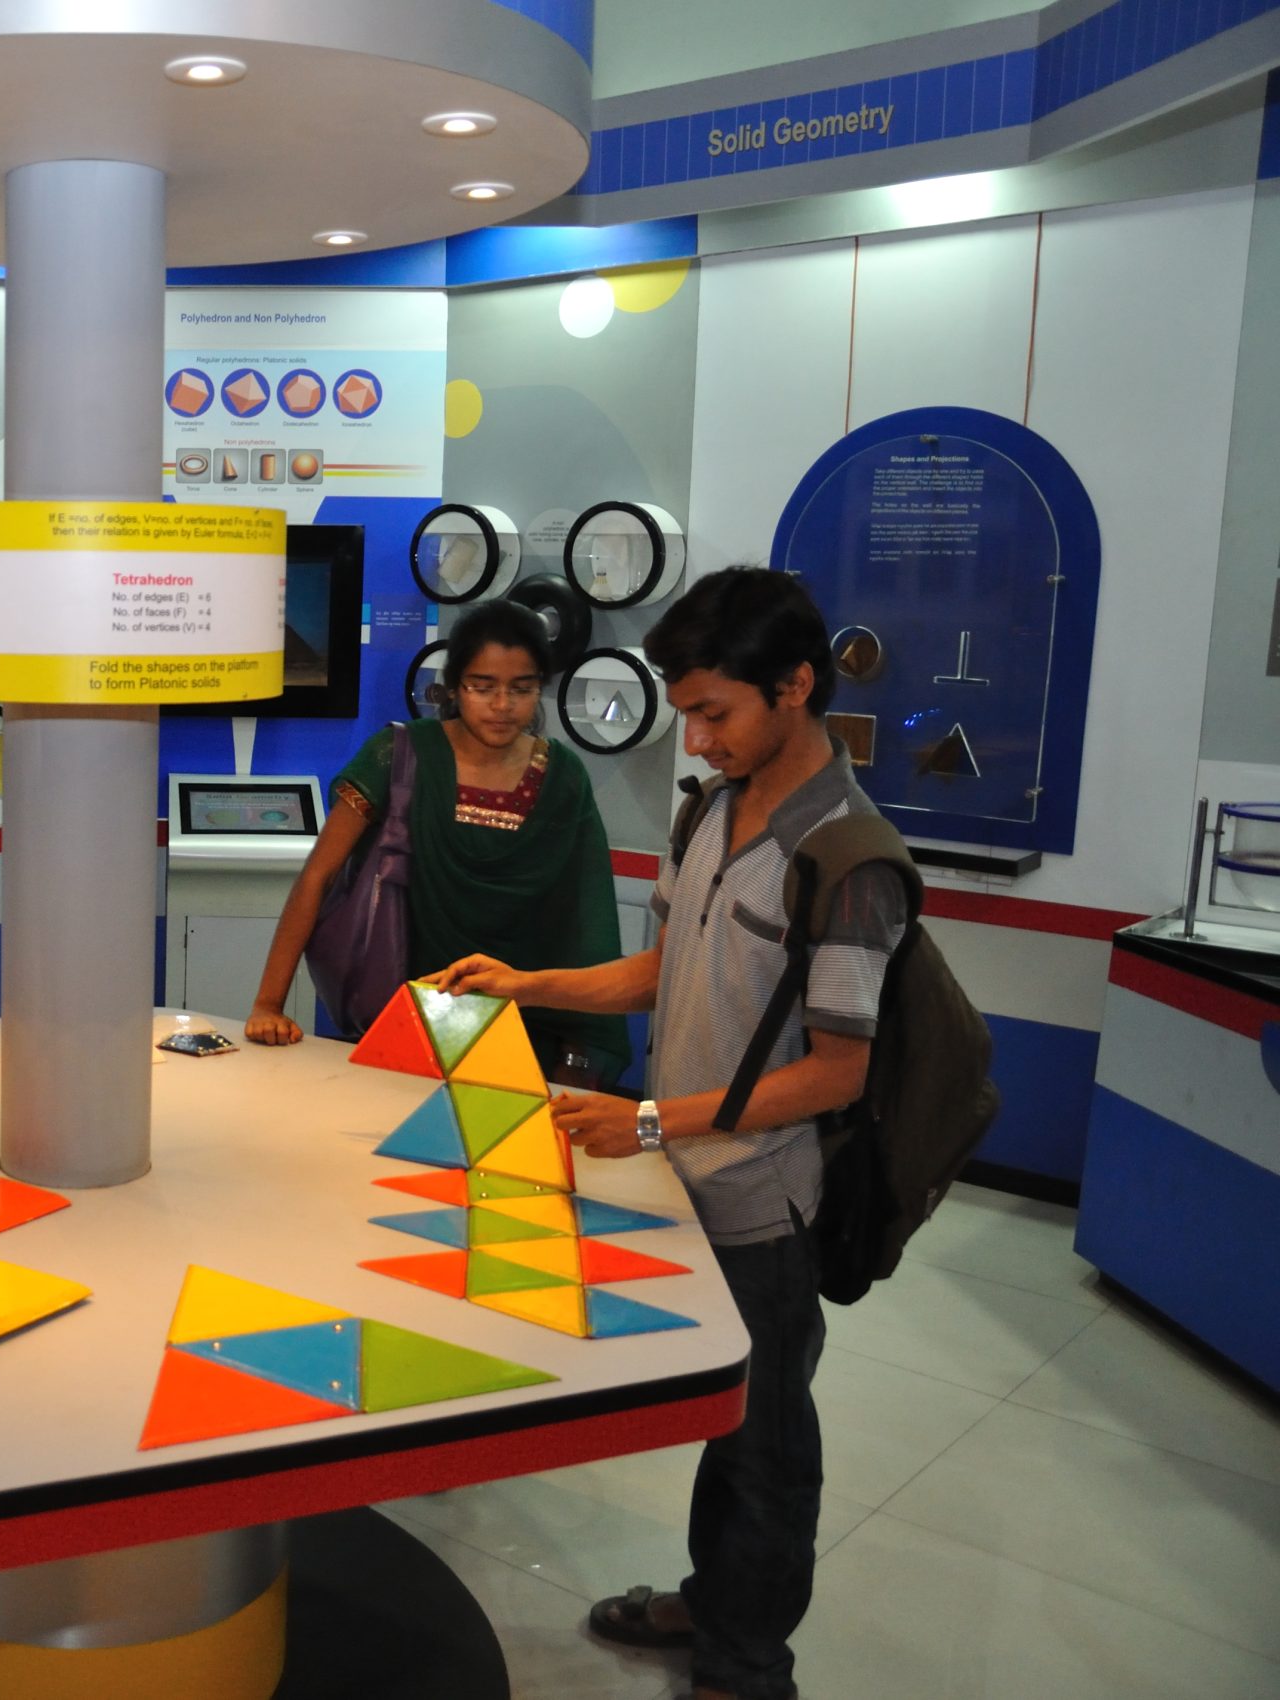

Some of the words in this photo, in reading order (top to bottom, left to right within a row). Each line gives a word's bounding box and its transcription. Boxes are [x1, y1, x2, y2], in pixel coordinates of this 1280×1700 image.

[707, 121, 766, 157] Solid
[773, 104, 895, 145] Geometry
[180, 312, 233, 324] Polyhedron
[234, 313, 251, 323] and
[254, 313, 272, 323] Non
[274, 313, 326, 325] Polyhedron
[94, 513, 105, 523] of
[174, 515, 184, 525] of
[52, 526, 75, 536] then
[78, 526, 100, 536] their
[103, 526, 140, 537] relation
[142, 527, 151, 537] is
[153, 528, 179, 539] given
[180, 528, 191, 539] by
[194, 528, 216, 538] Euler
[113, 572, 194, 586] Tetrahedron
[132, 592, 143, 601] of
[144, 592, 173, 604] edges
[176, 592, 189, 603] (E)
[133, 607, 144, 617] of
[145, 607, 170, 617] faces
[173, 607, 187, 618] (F)
[205, 608, 211, 617] 4
[132, 623, 142, 632] of
[144, 623, 180, 632] vertices
[182, 623, 196, 633] (V)
[205, 623, 211, 631] 4
[89, 660, 119, 673] Fold
[123, 661, 143, 673] the
[147, 661, 190, 675] shapes
[193, 662, 207, 672] on
[210, 660, 225, 671] the
[89, 678, 102, 689] to
[106, 677, 135, 689] form
[139, 677, 188, 689] Platonic
[191, 676, 221, 688] solids
